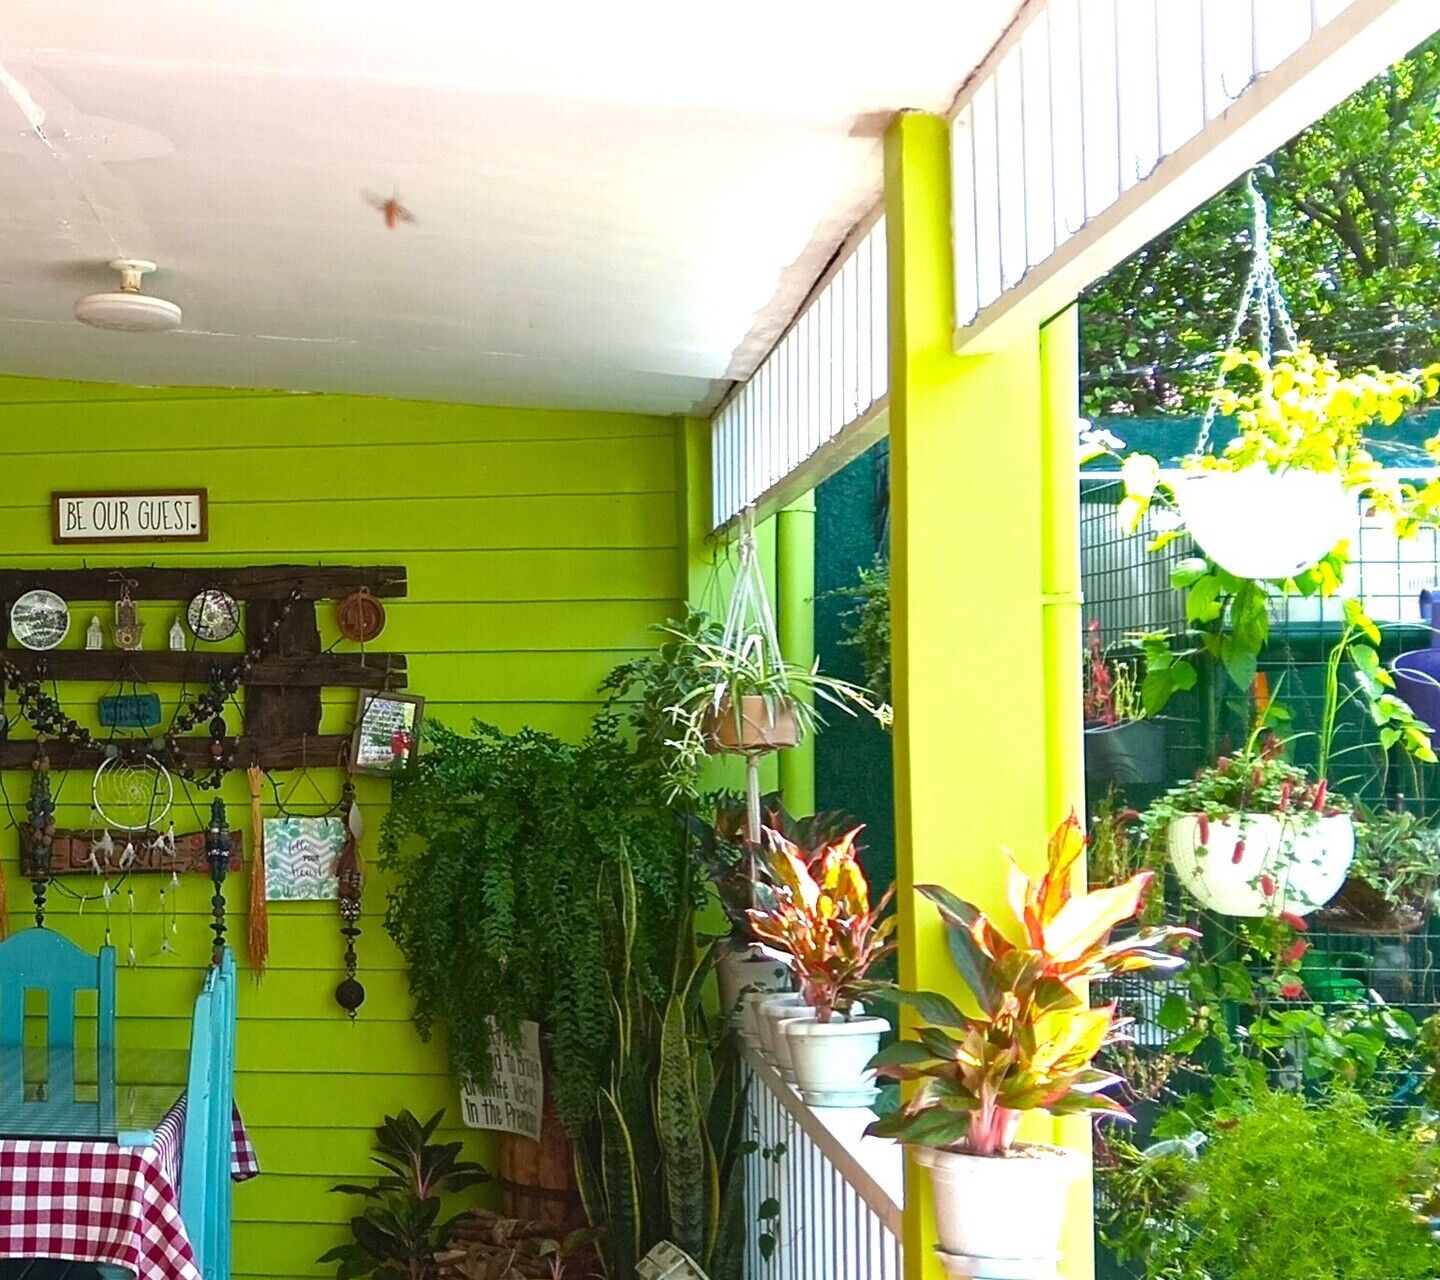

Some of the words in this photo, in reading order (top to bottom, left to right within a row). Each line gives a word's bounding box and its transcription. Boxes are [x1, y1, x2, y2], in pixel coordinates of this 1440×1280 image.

[66, 500, 87, 531] BE
[92, 500, 130, 531] OUR
[465, 1098, 479, 1123] In
[481, 1098, 503, 1125] the
